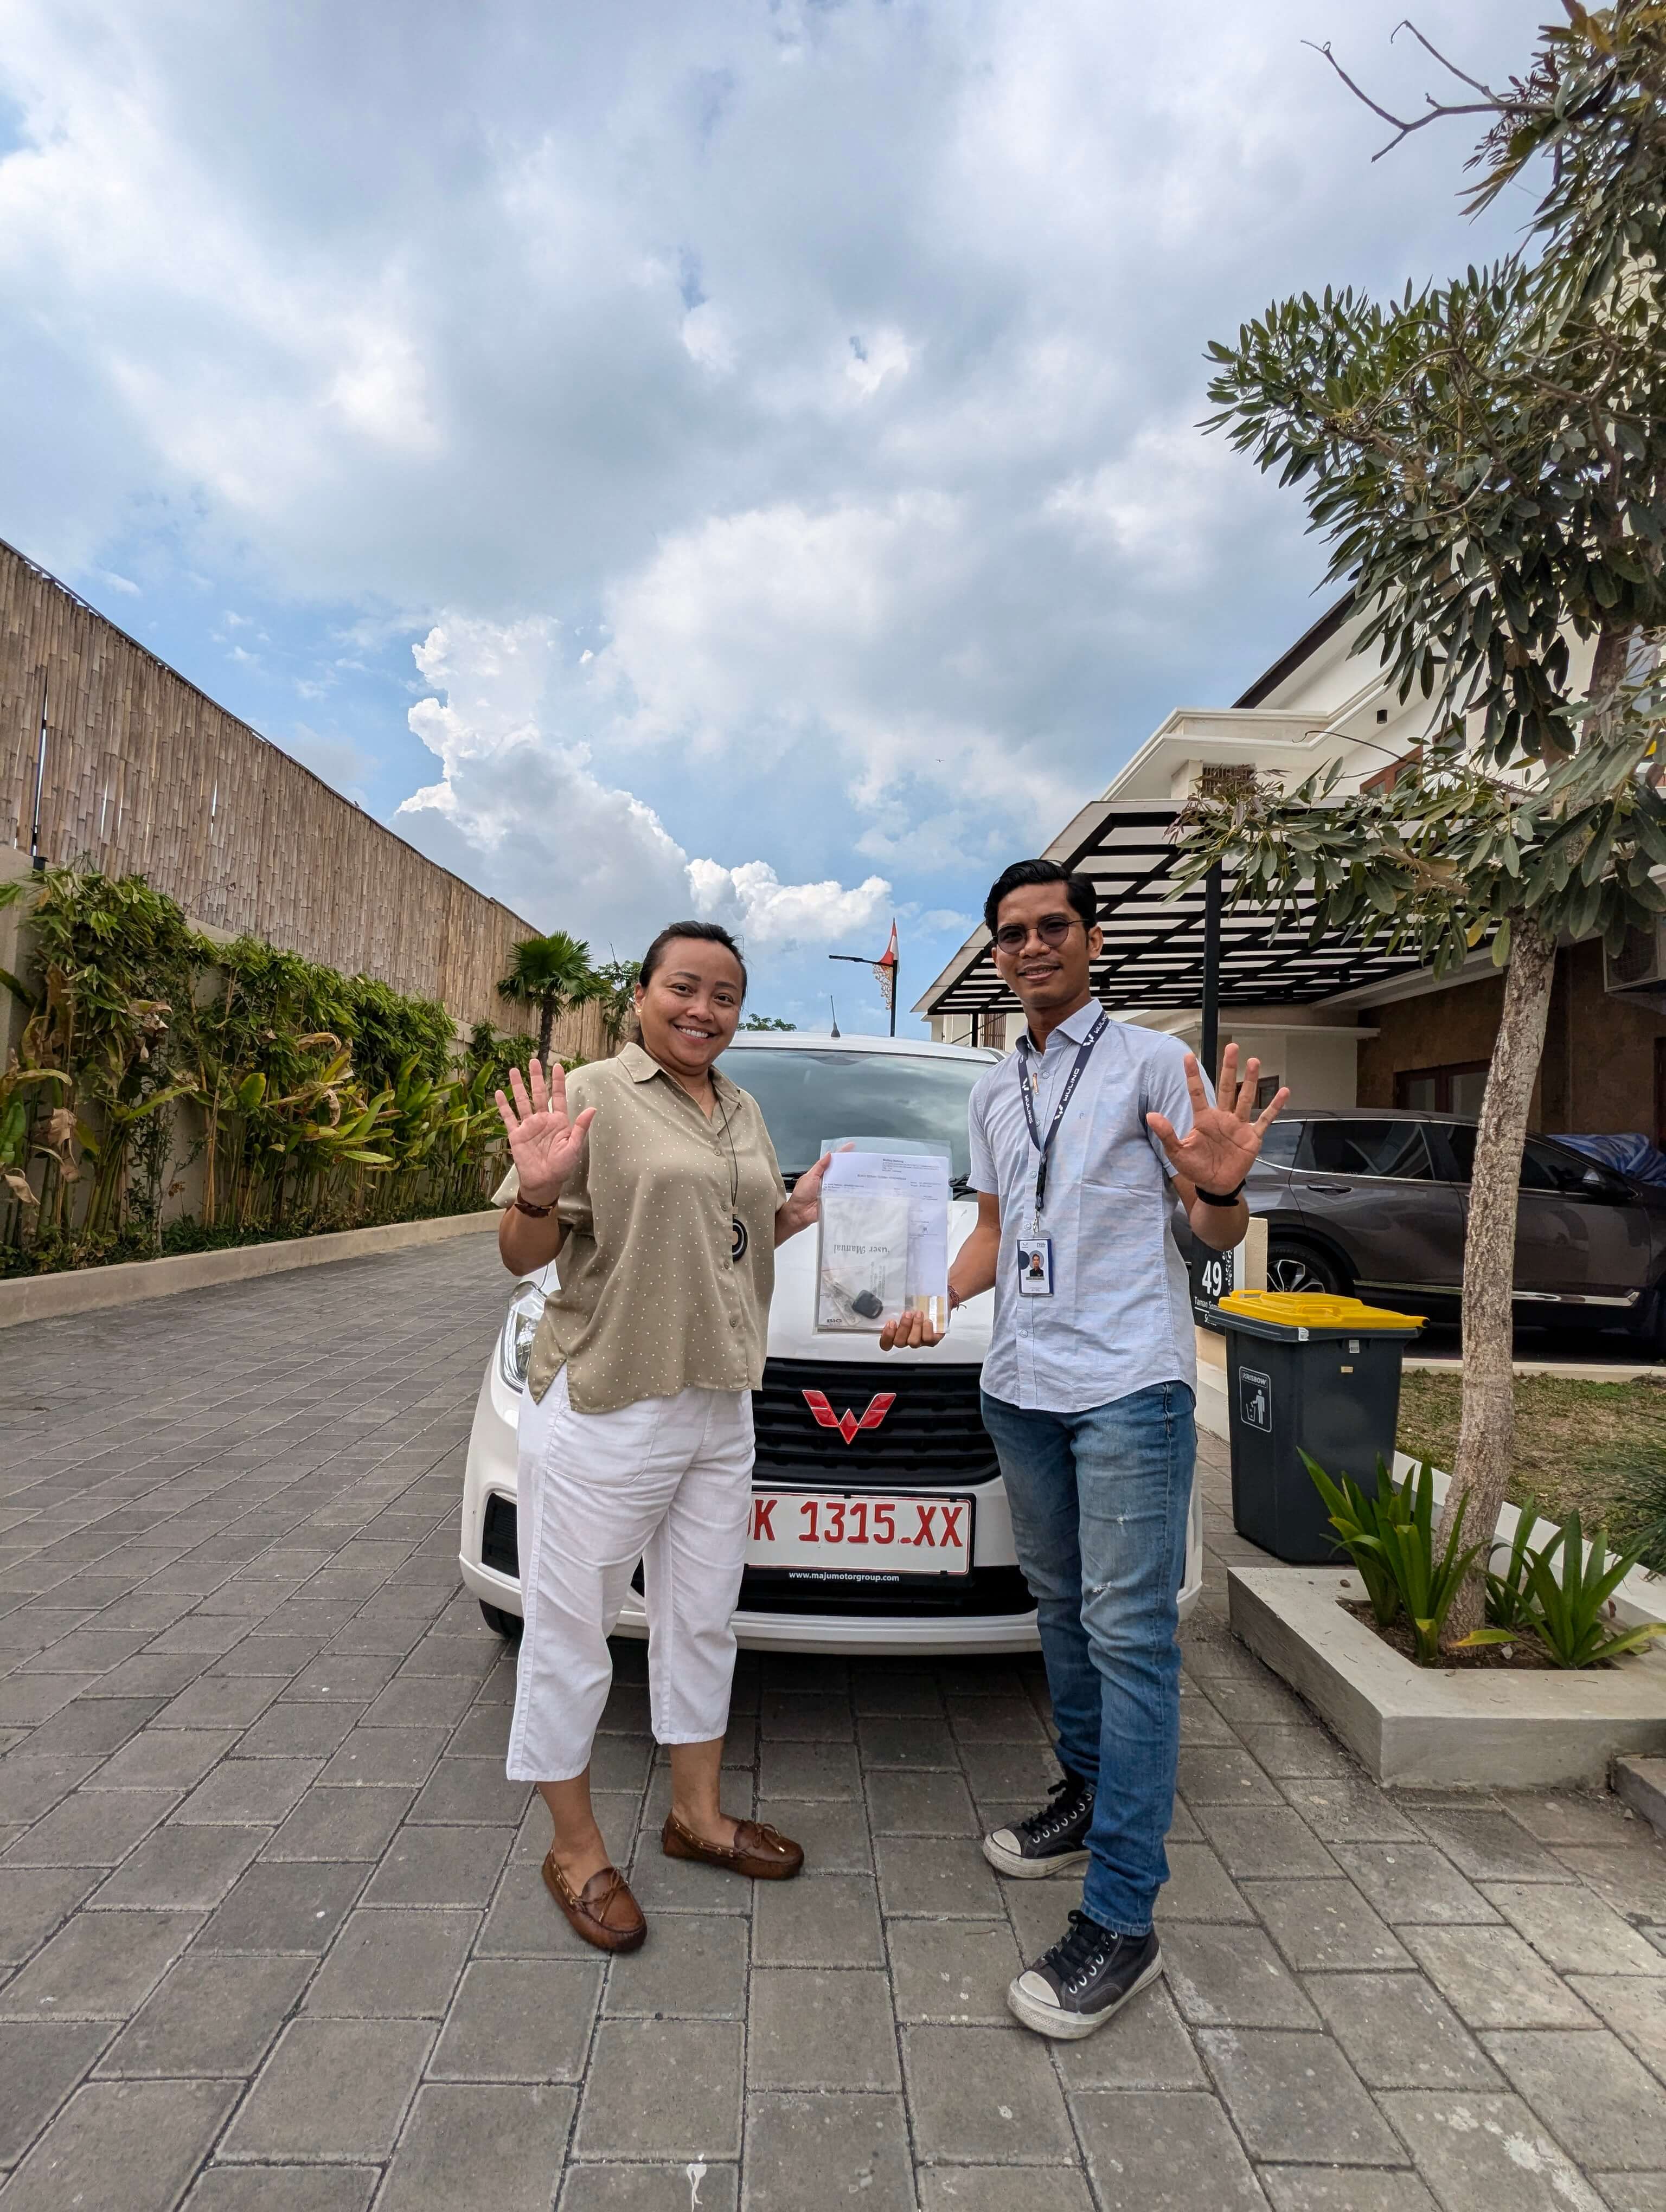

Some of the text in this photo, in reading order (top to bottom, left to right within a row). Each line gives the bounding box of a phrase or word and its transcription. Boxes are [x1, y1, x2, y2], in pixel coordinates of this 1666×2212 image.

[1063, 1068, 1080, 1102] WULING
[1024, 1094, 1033, 1124] WULING
[1202, 1260, 1222, 1297] 49
[1243, 1372, 1267, 1385] KRISBOW
[746, 1499, 778, 1541] K
[789, 1571, 900, 1582] www.majumotorgroup.com
